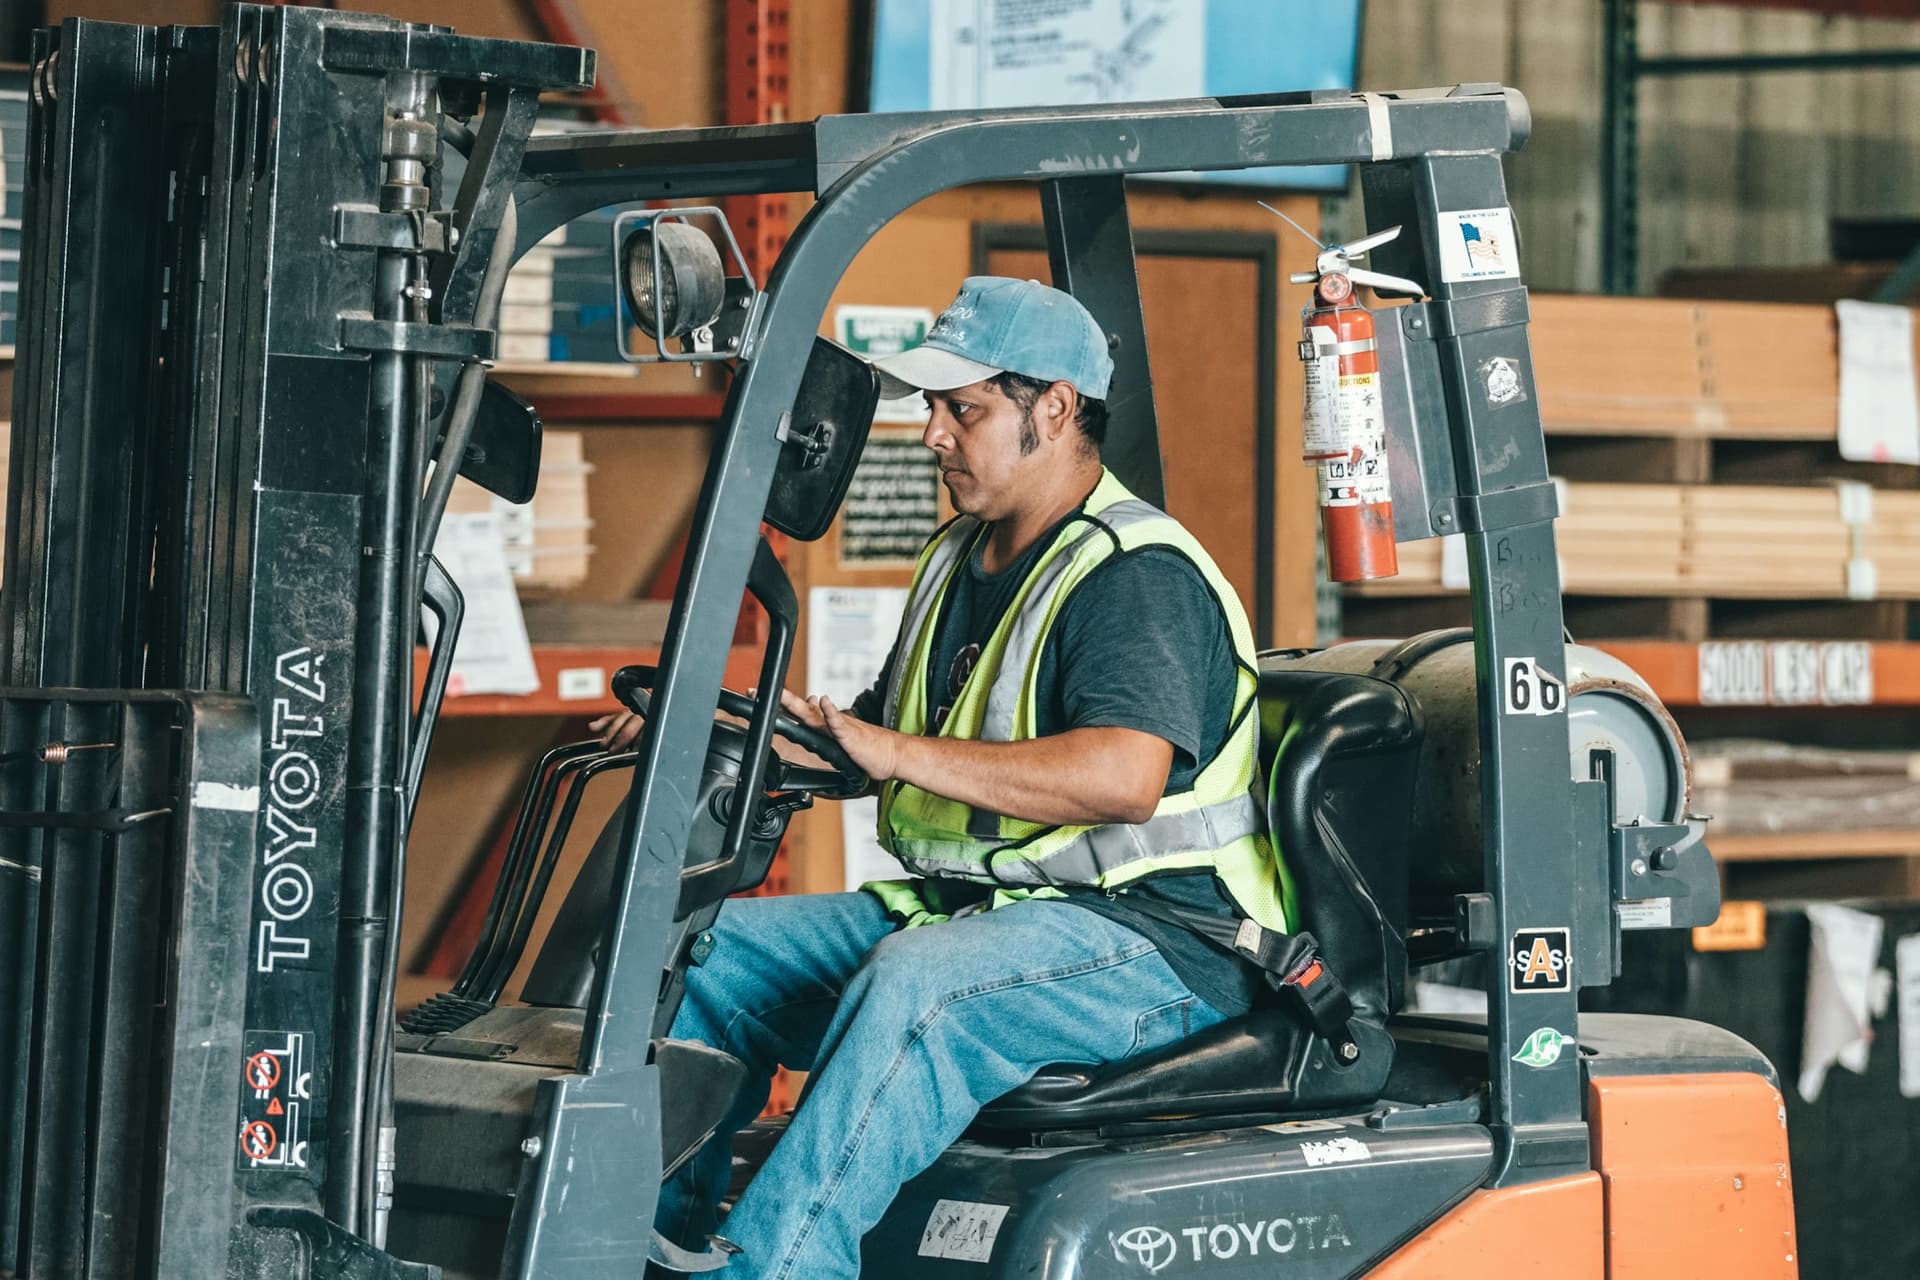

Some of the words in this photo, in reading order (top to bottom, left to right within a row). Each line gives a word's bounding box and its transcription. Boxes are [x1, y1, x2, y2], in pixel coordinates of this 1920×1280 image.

[257, 646, 328, 974] TOYOTA
[1516, 937, 1564, 983] SAS
[1182, 1213, 1352, 1262] TOYOTA
